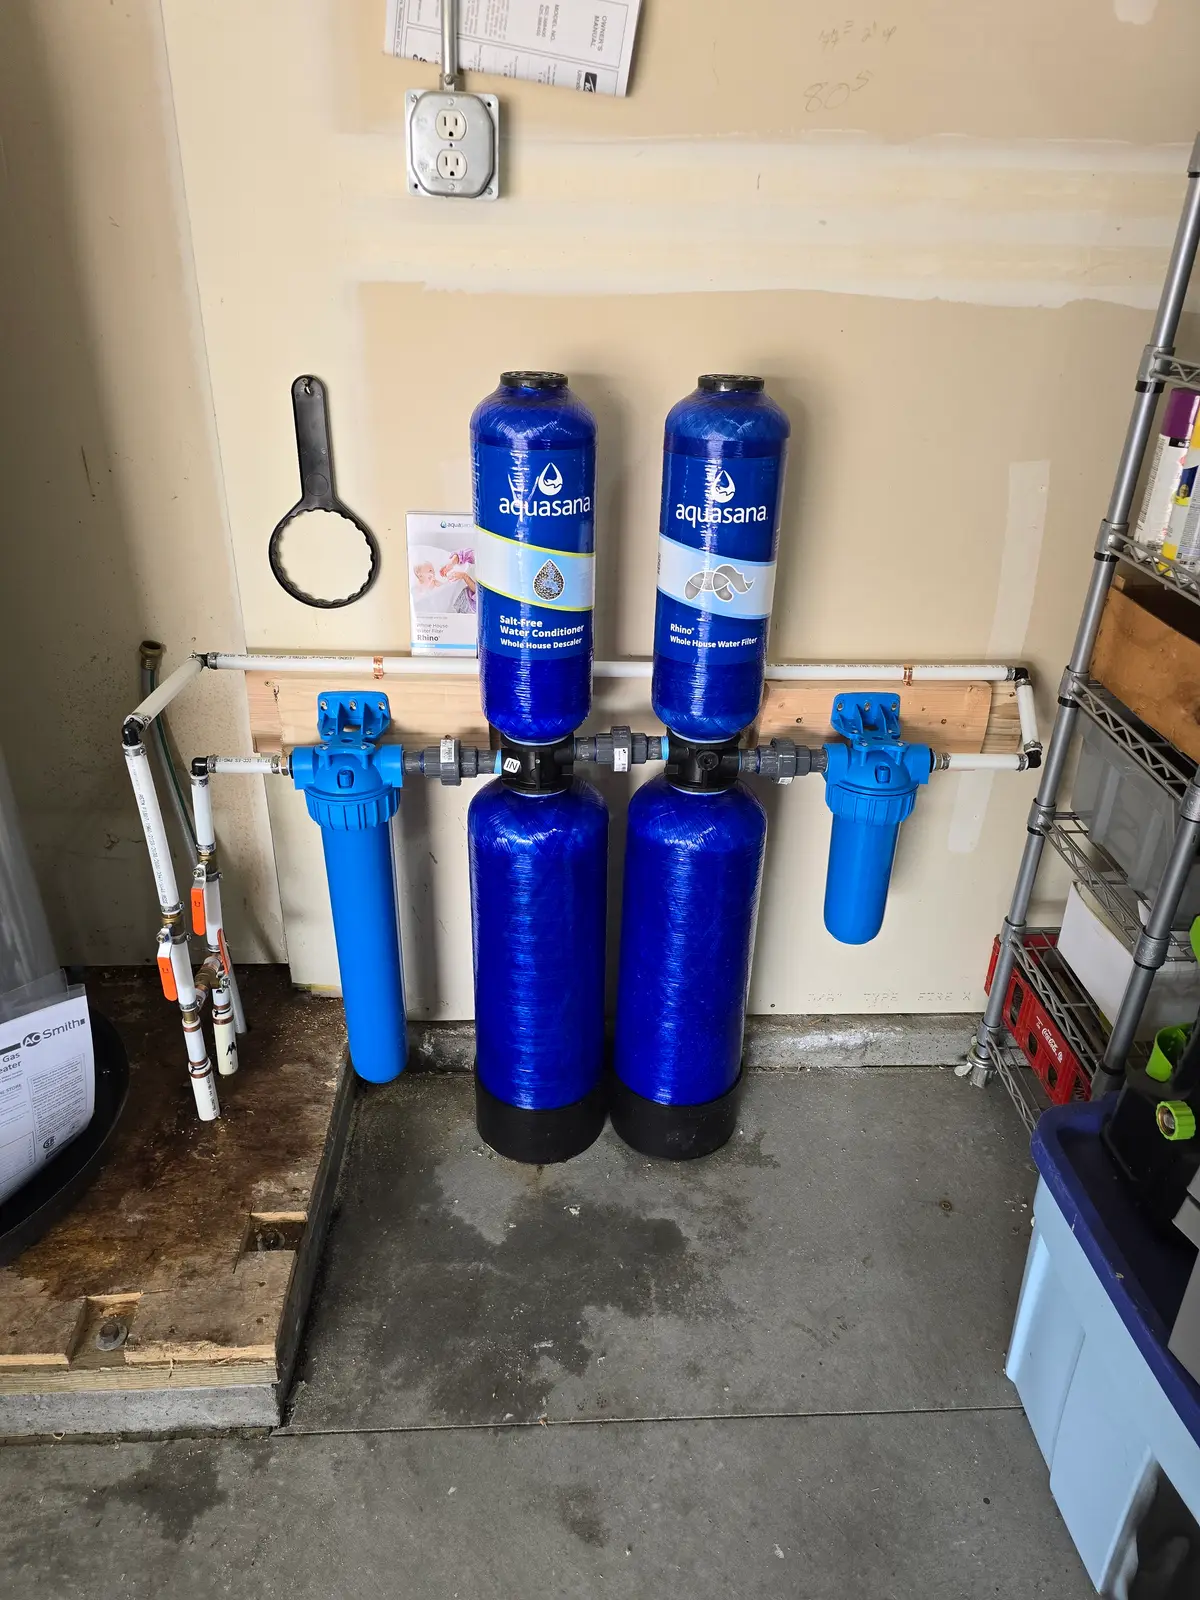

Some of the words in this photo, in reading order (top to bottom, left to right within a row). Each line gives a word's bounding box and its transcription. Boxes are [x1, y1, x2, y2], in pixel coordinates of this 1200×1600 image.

[590, 15, 599, 48] MANUAL
[597, 15, 607, 52] OWNER'S
[499, 496, 591, 522] aquasana
[675, 503, 767, 528] aquasana
[500, 615, 543, 628] Salt-Free
[500, 625, 530, 637] Water
[532, 624, 585, 638] Conditioner
[500, 638, 525, 649] Whole
[526, 641, 552, 650] House
[553, 638, 583, 650] Descaler
[670, 635, 691, 647] Whole
[692, 639, 716, 649] House
[717, 640, 741, 648] Water
[741, 637, 758, 647] Filter
[505, 762, 519, 771] IN
[863, 992, 899, 1003] TYPE
[42, 1019, 80, 1039] Smith
[2, 1052, 20, 1063] Gas
[0, 1061, 21, 1074] eater
